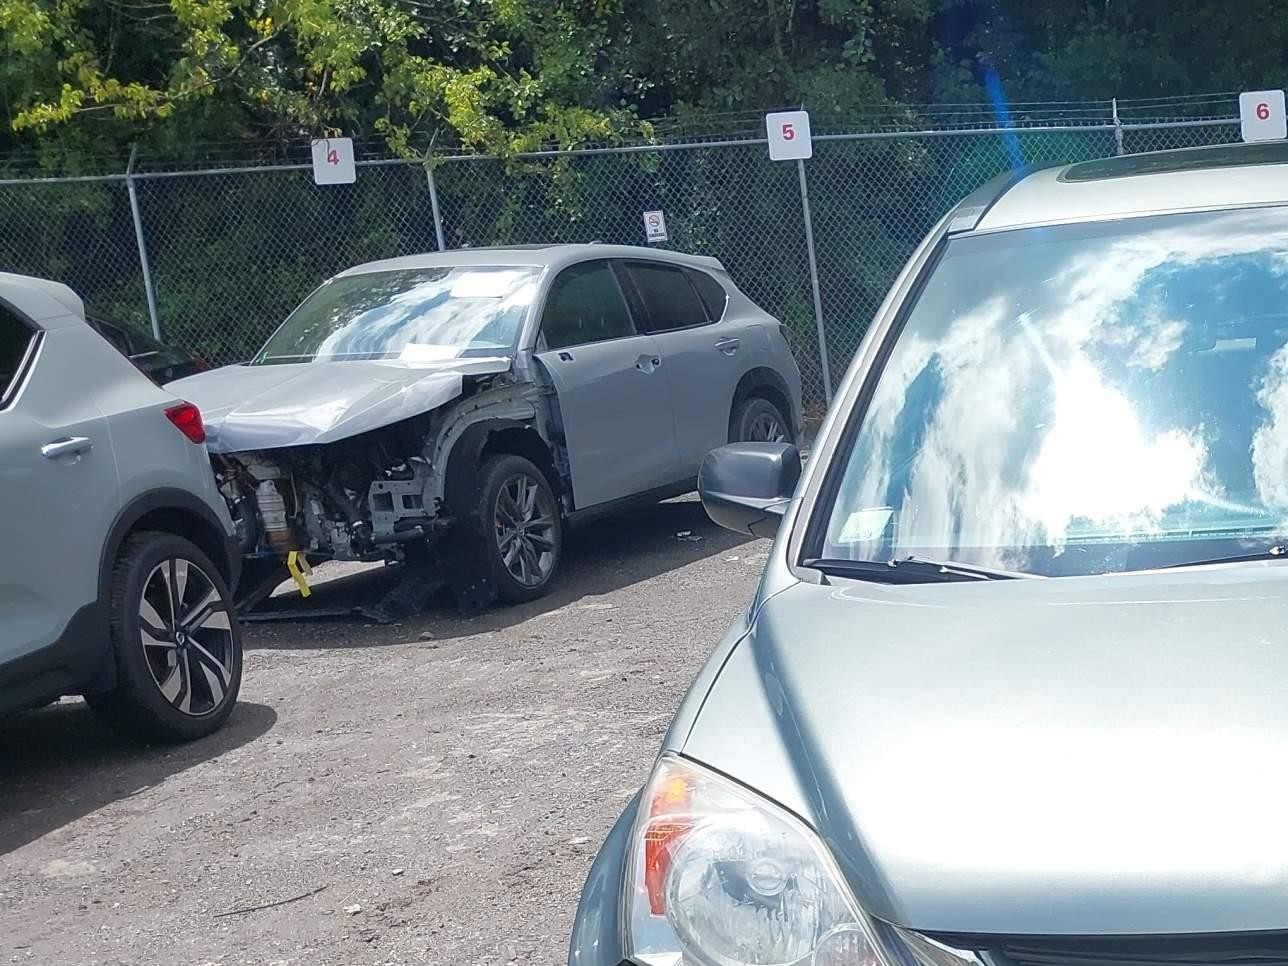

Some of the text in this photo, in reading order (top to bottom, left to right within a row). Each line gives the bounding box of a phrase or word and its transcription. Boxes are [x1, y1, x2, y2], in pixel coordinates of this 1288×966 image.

[1256, 103, 1270, 120] 6
[782, 124, 795, 141] 5
[326, 149, 341, 166] 4
